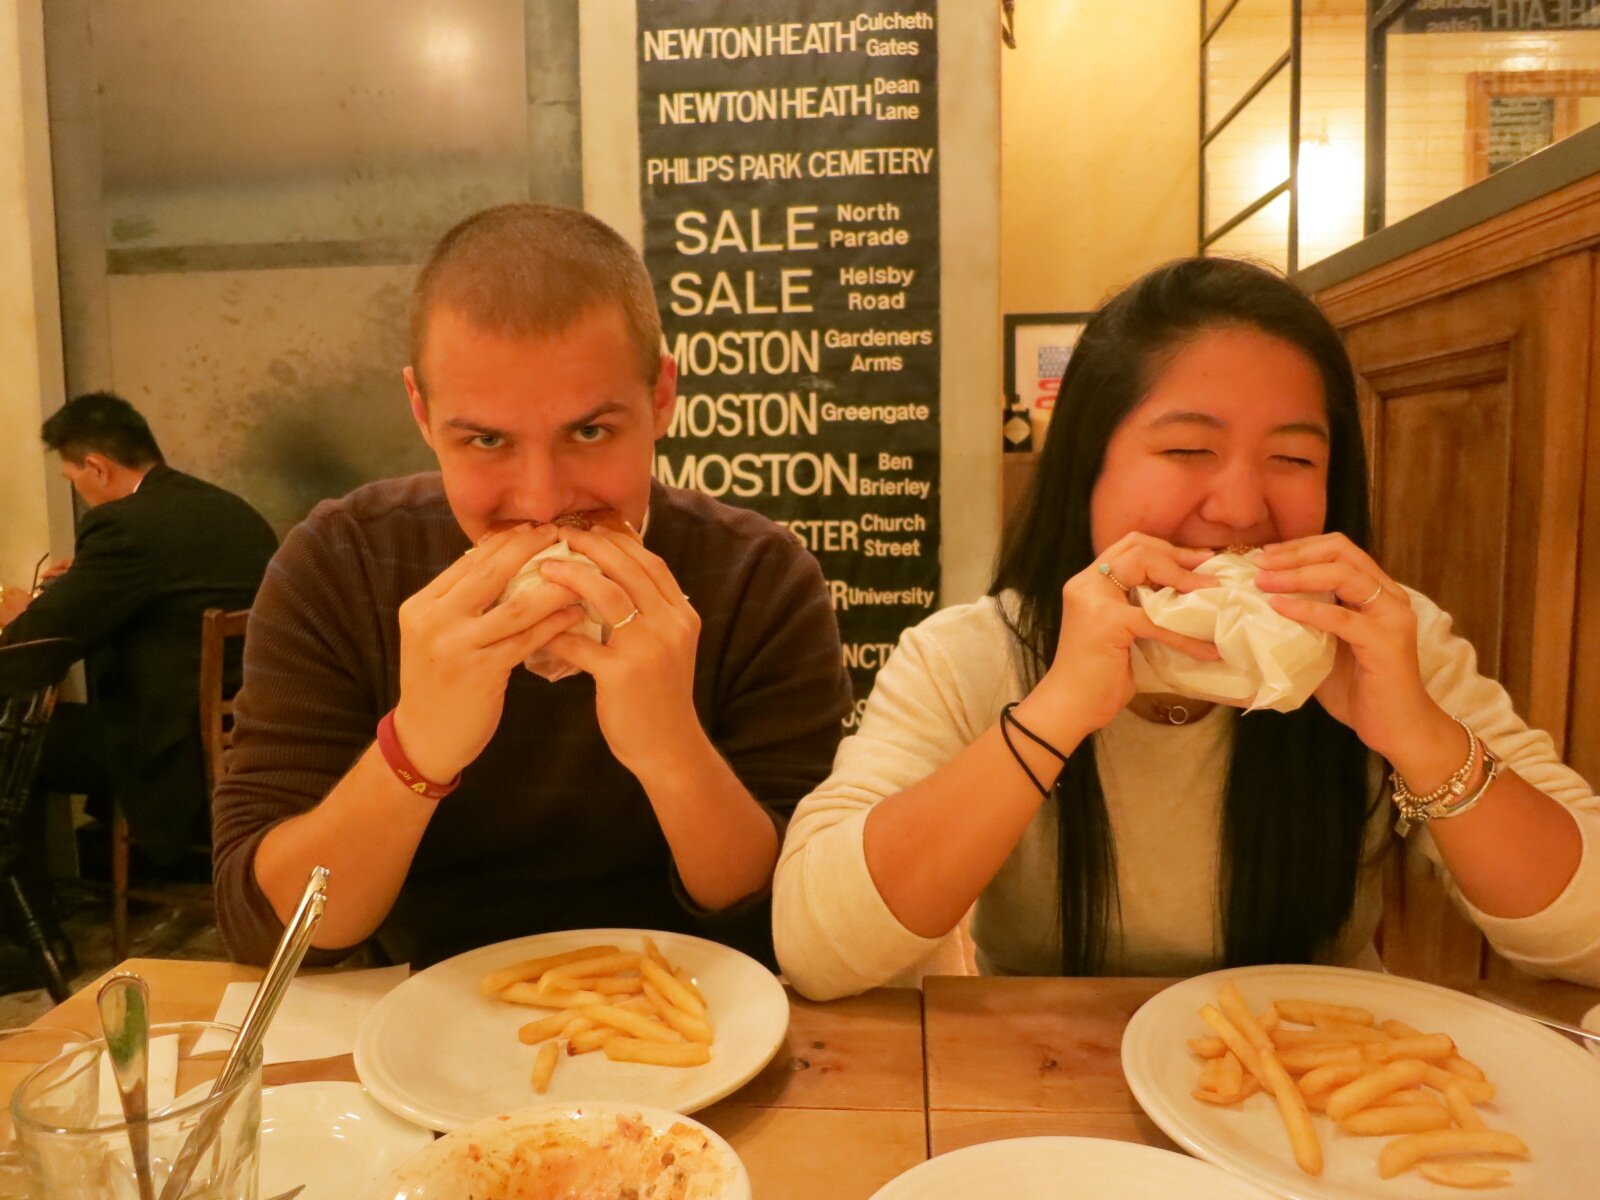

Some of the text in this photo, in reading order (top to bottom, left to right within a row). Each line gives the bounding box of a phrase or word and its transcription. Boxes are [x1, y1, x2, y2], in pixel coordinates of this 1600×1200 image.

[856, 12, 933, 30] Culcheth
[644, 21, 856, 61] NEWTON HEATH
[866, 38, 919, 56] Gates
[874, 78, 919, 95] Dean
[659, 84, 872, 124] NEWTON HEATH
[876, 103, 919, 120] Lane
[648, 148, 933, 184] PHILIPS PARK CEMETERY
[837, 203, 899, 221] North
[675, 206, 819, 255] SALE
[829, 228, 909, 247] Parade
[840, 267, 914, 286] Helsby
[670, 269, 813, 316] SALE
[848, 292, 905, 310] Road
[825, 329, 932, 348] Gardeners
[661, 330, 819, 375] MOSTON
[851, 354, 903, 372] Arms
[821, 403, 929, 424] Greengate
[878, 453, 913, 470] Ben
[658, 452, 857, 497] MOSTON
[860, 478, 930, 499] Brierley
[861, 514, 925, 531] Church
[775, 520, 858, 551] STER
[865, 539, 921, 556] Street
[849, 588, 934, 608] University
